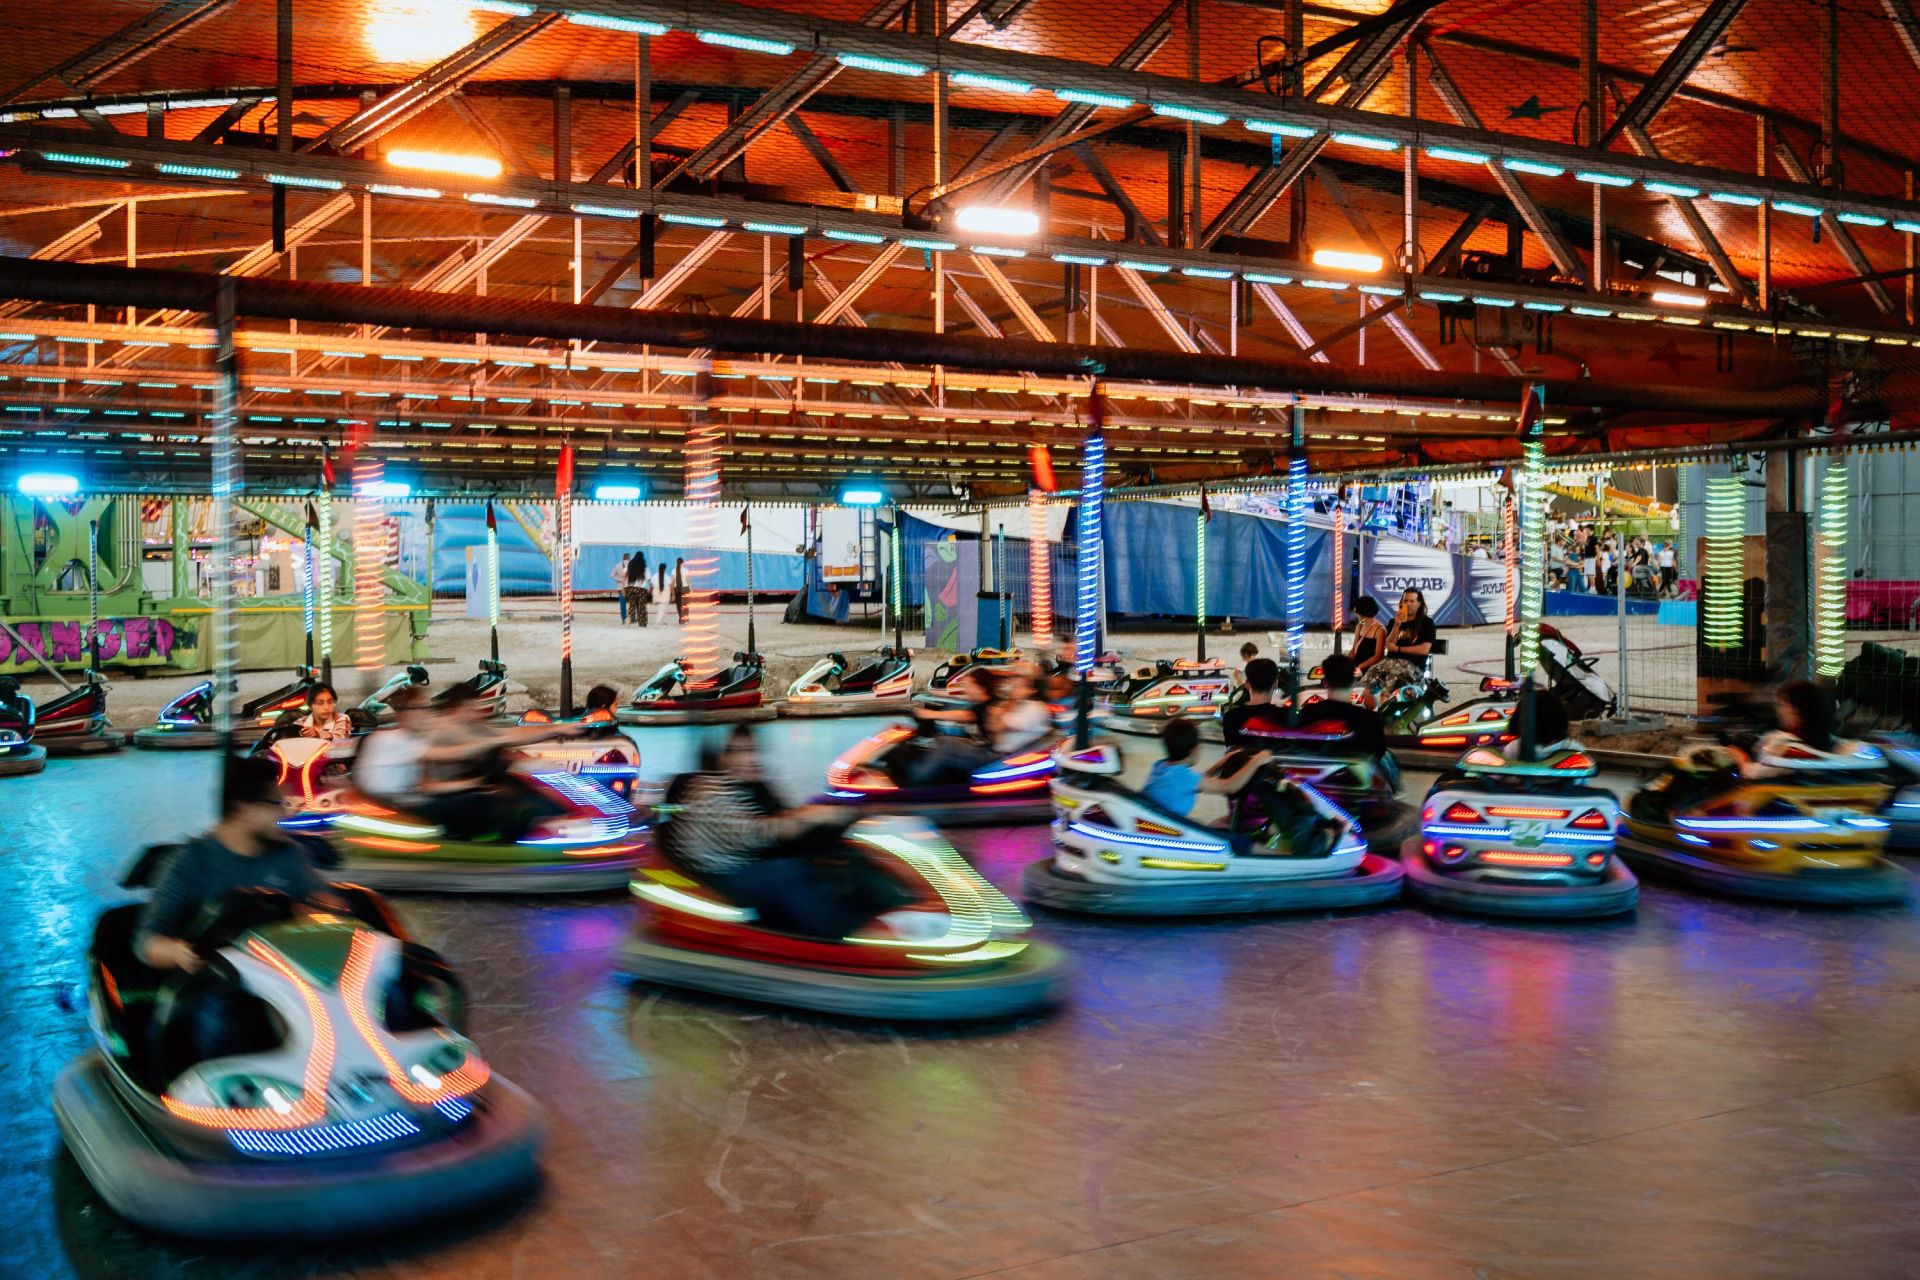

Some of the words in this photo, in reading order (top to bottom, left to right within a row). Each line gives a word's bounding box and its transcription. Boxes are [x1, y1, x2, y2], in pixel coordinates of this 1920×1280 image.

[1380, 576, 1444, 591] SKYLAB
[1200, 690, 1213, 702] 21
[1509, 820, 1549, 841] 24
